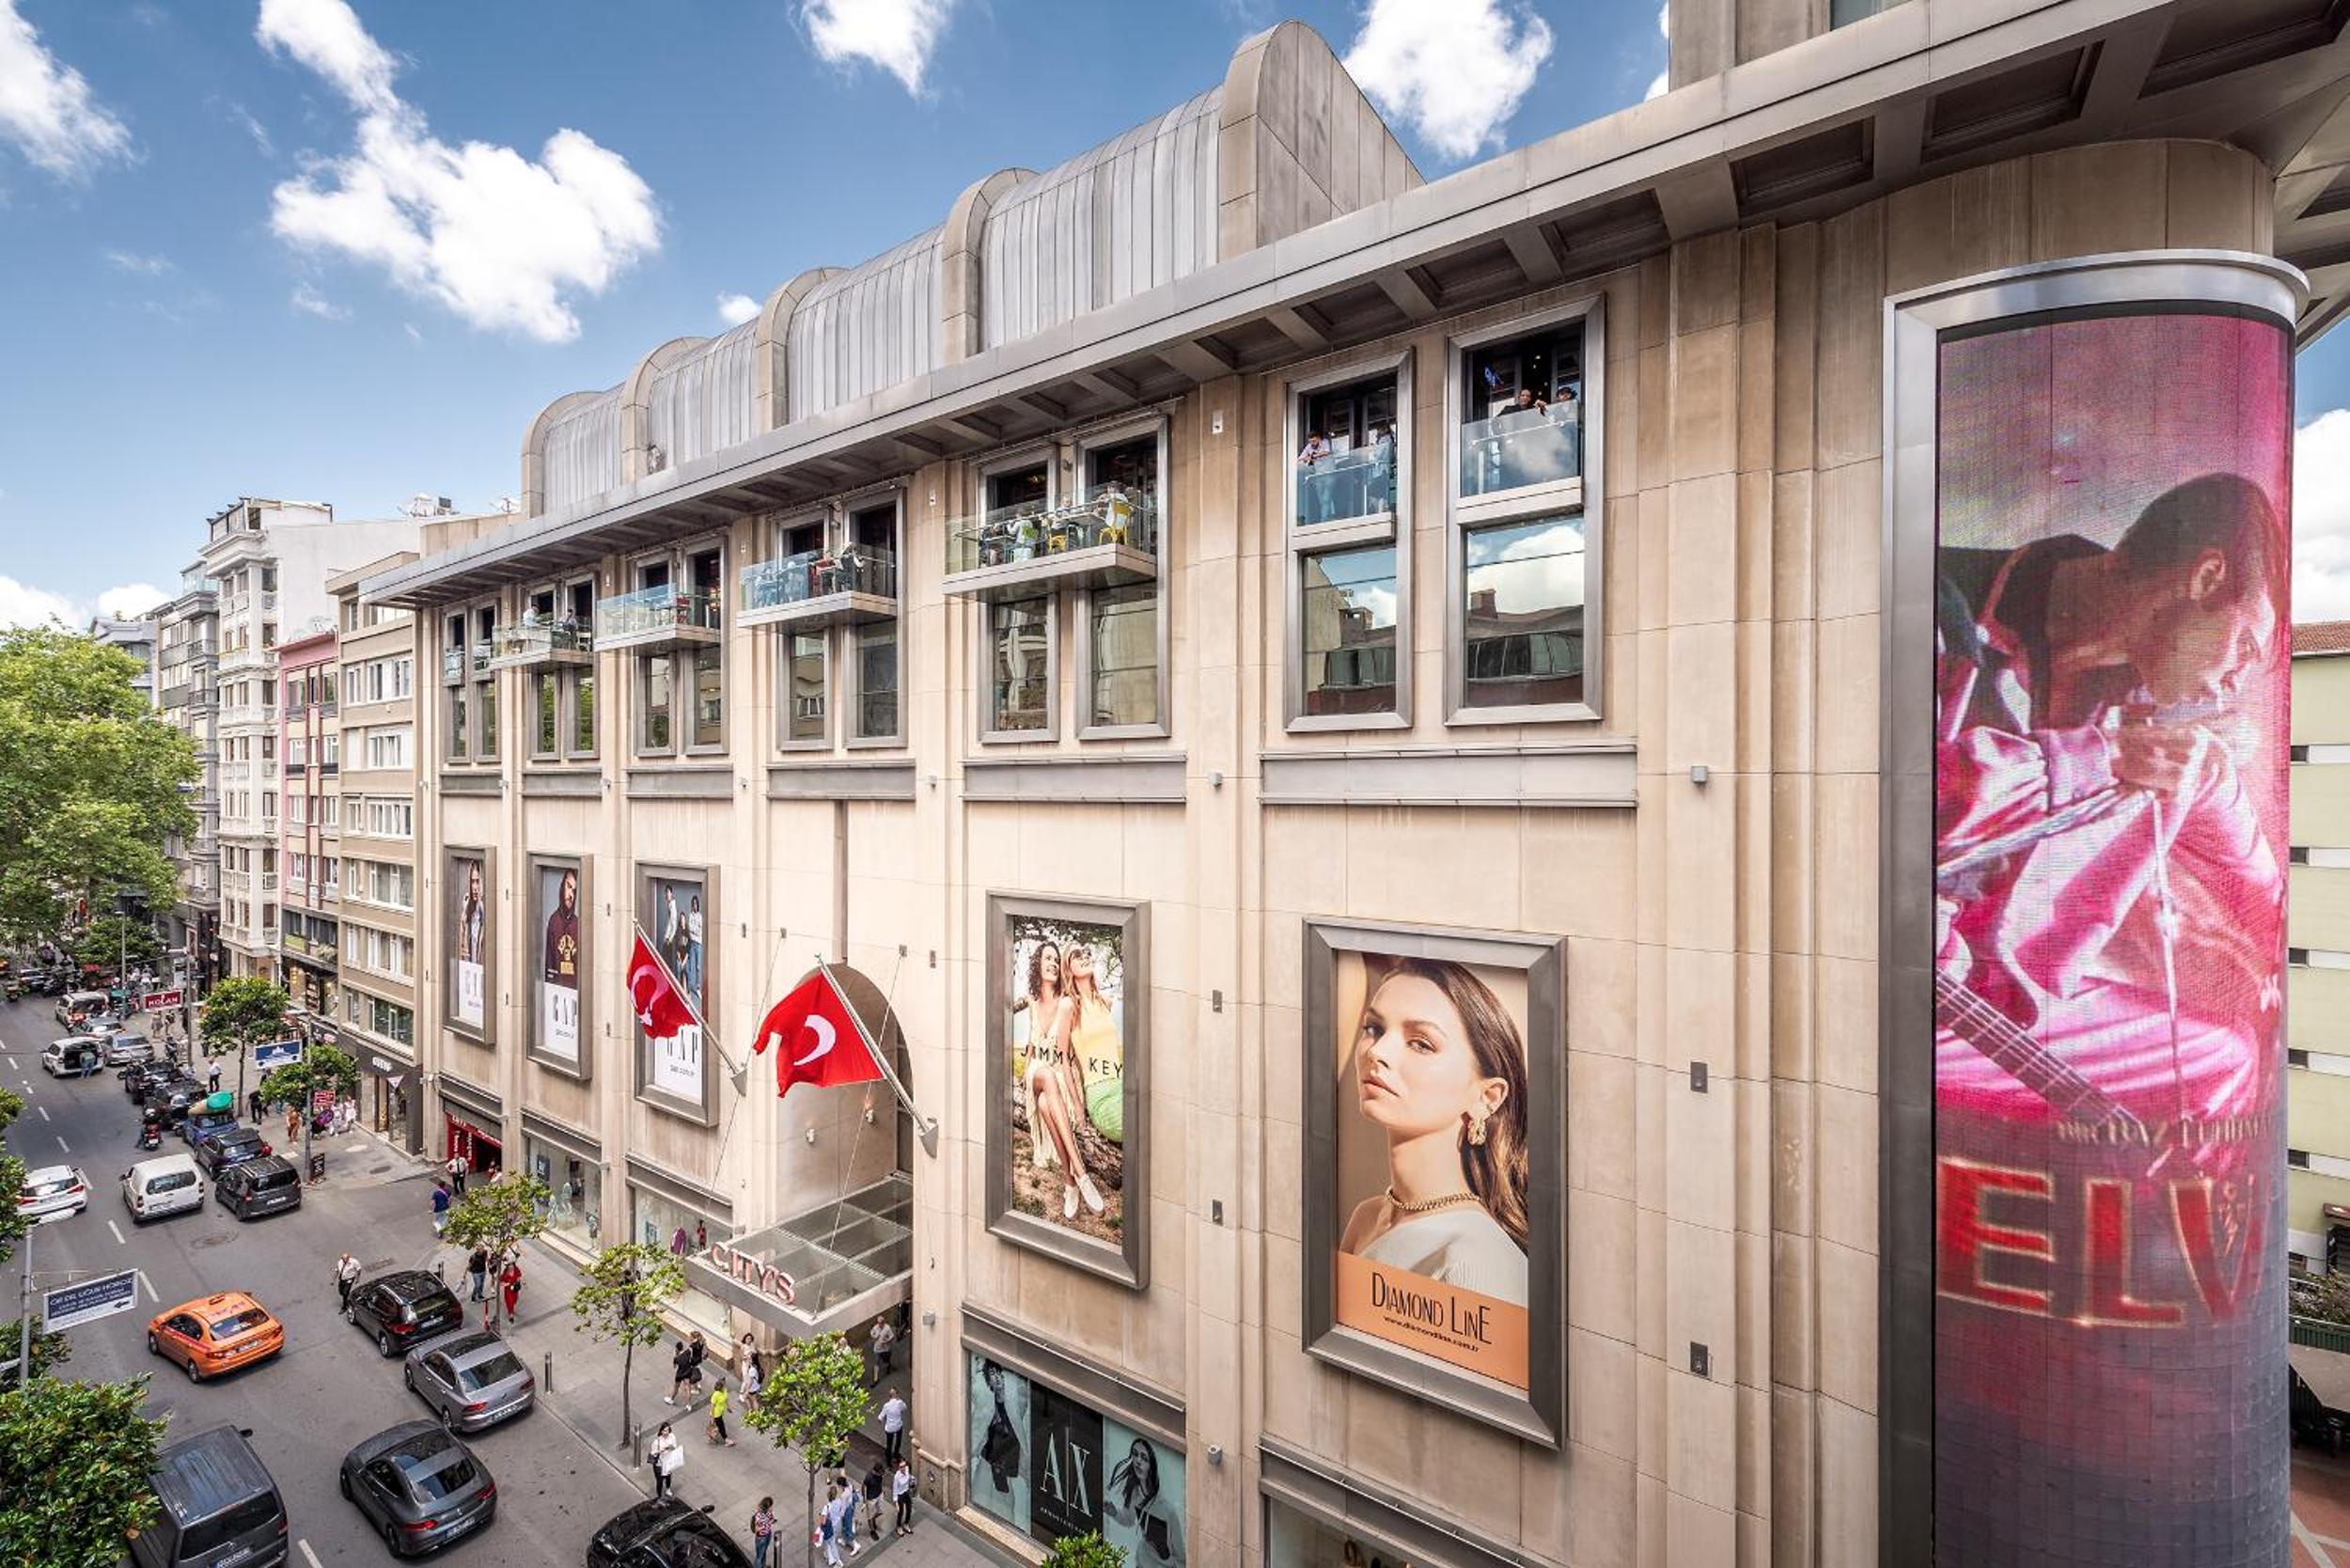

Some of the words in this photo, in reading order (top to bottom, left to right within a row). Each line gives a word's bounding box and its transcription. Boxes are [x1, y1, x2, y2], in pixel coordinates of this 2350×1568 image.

[1021, 1044, 1075, 1067] JIMMY
[1089, 1057, 1122, 1078] KEY
[1372, 1272, 1444, 1328] DIAMOND
[1451, 1295, 1492, 1344] LINE
